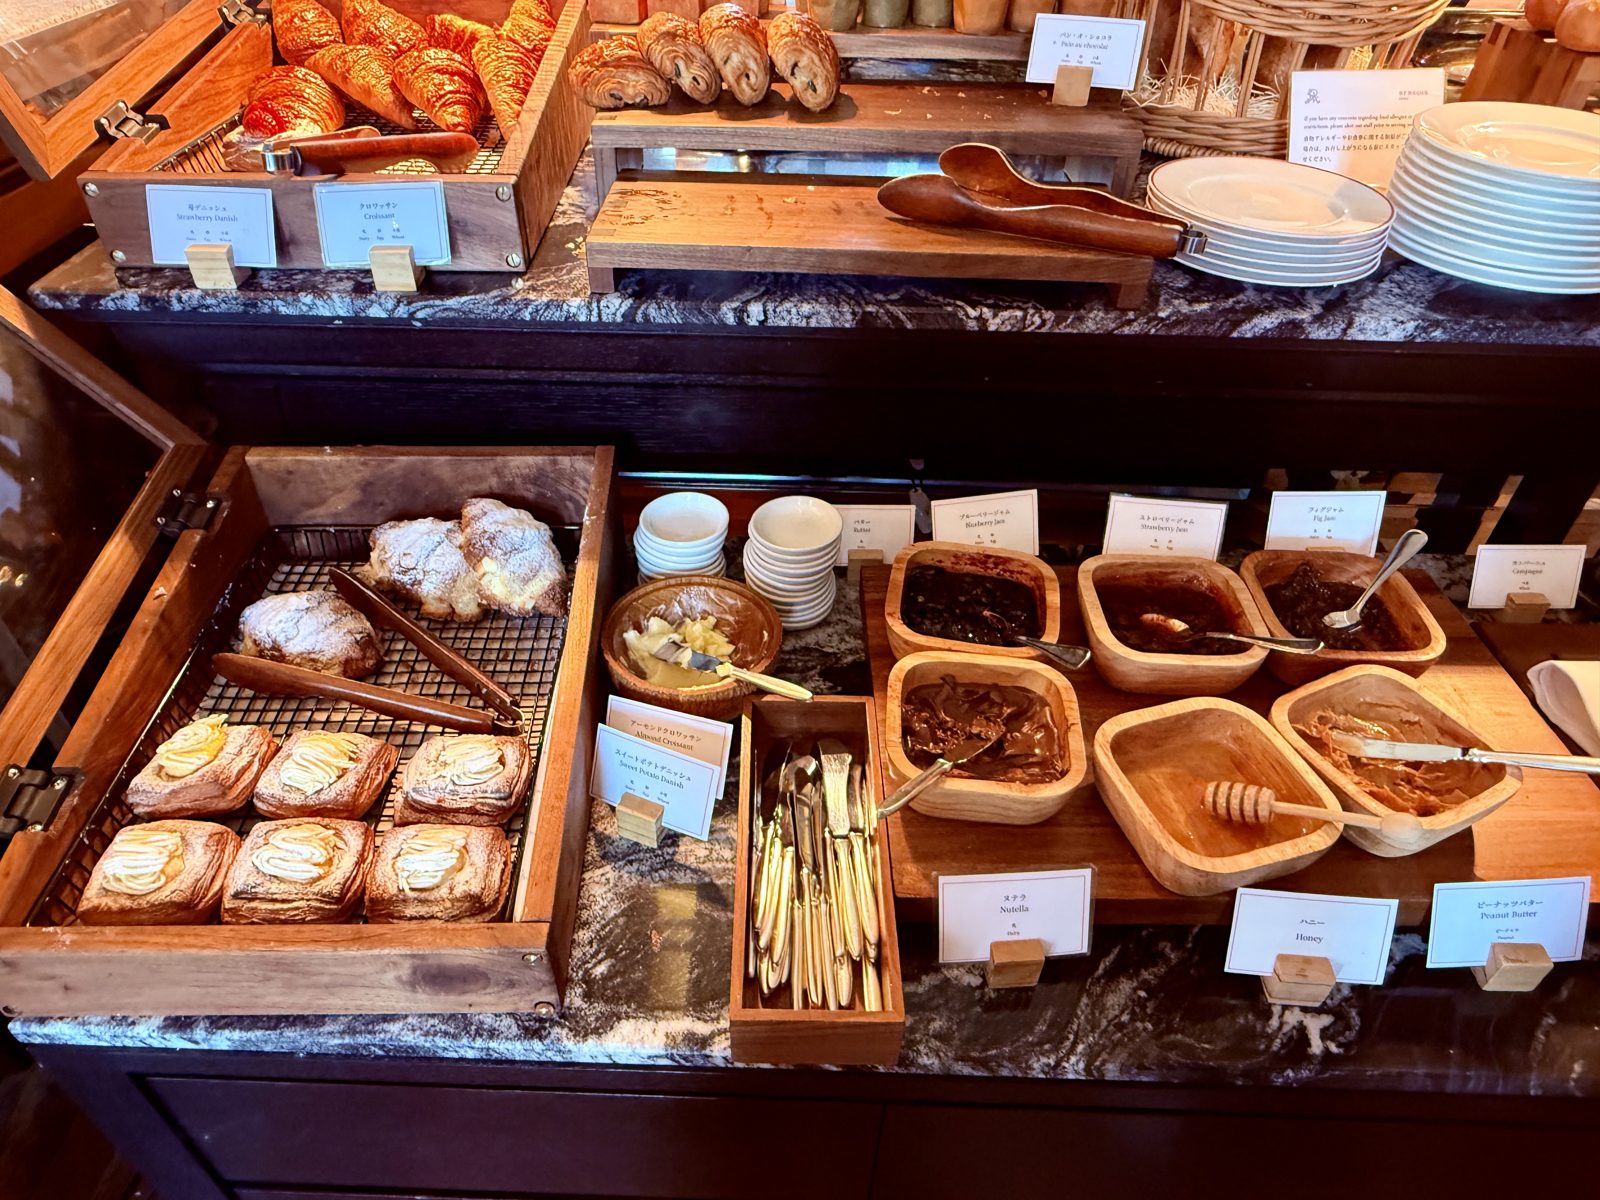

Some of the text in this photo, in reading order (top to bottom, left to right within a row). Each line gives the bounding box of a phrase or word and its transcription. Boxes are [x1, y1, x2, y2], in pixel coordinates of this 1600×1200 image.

[359, 202, 398, 210] クロワッサン
[176, 213, 239, 223] Strawberry Danish
[363, 212, 395, 220] Croissant
[1312, 514, 1323, 523] Fig
[1140, 523, 1174, 532] Strawberry
[630, 720, 702, 742] アーモンドクロワッサン
[634, 730, 694, 751] Almond Croissant
[614, 748, 692, 782] スイートポテトデニッシュ
[619, 760, 685, 790] Sweet Potato Danish
[1003, 893, 1027, 902] ヌテラ
[1000, 904, 1029, 914] Nutella
[1477, 899, 1544, 909] ピーナッツバター
[1480, 910, 1539, 920] Peanut Butter
[1295, 933, 1324, 944] Honey
